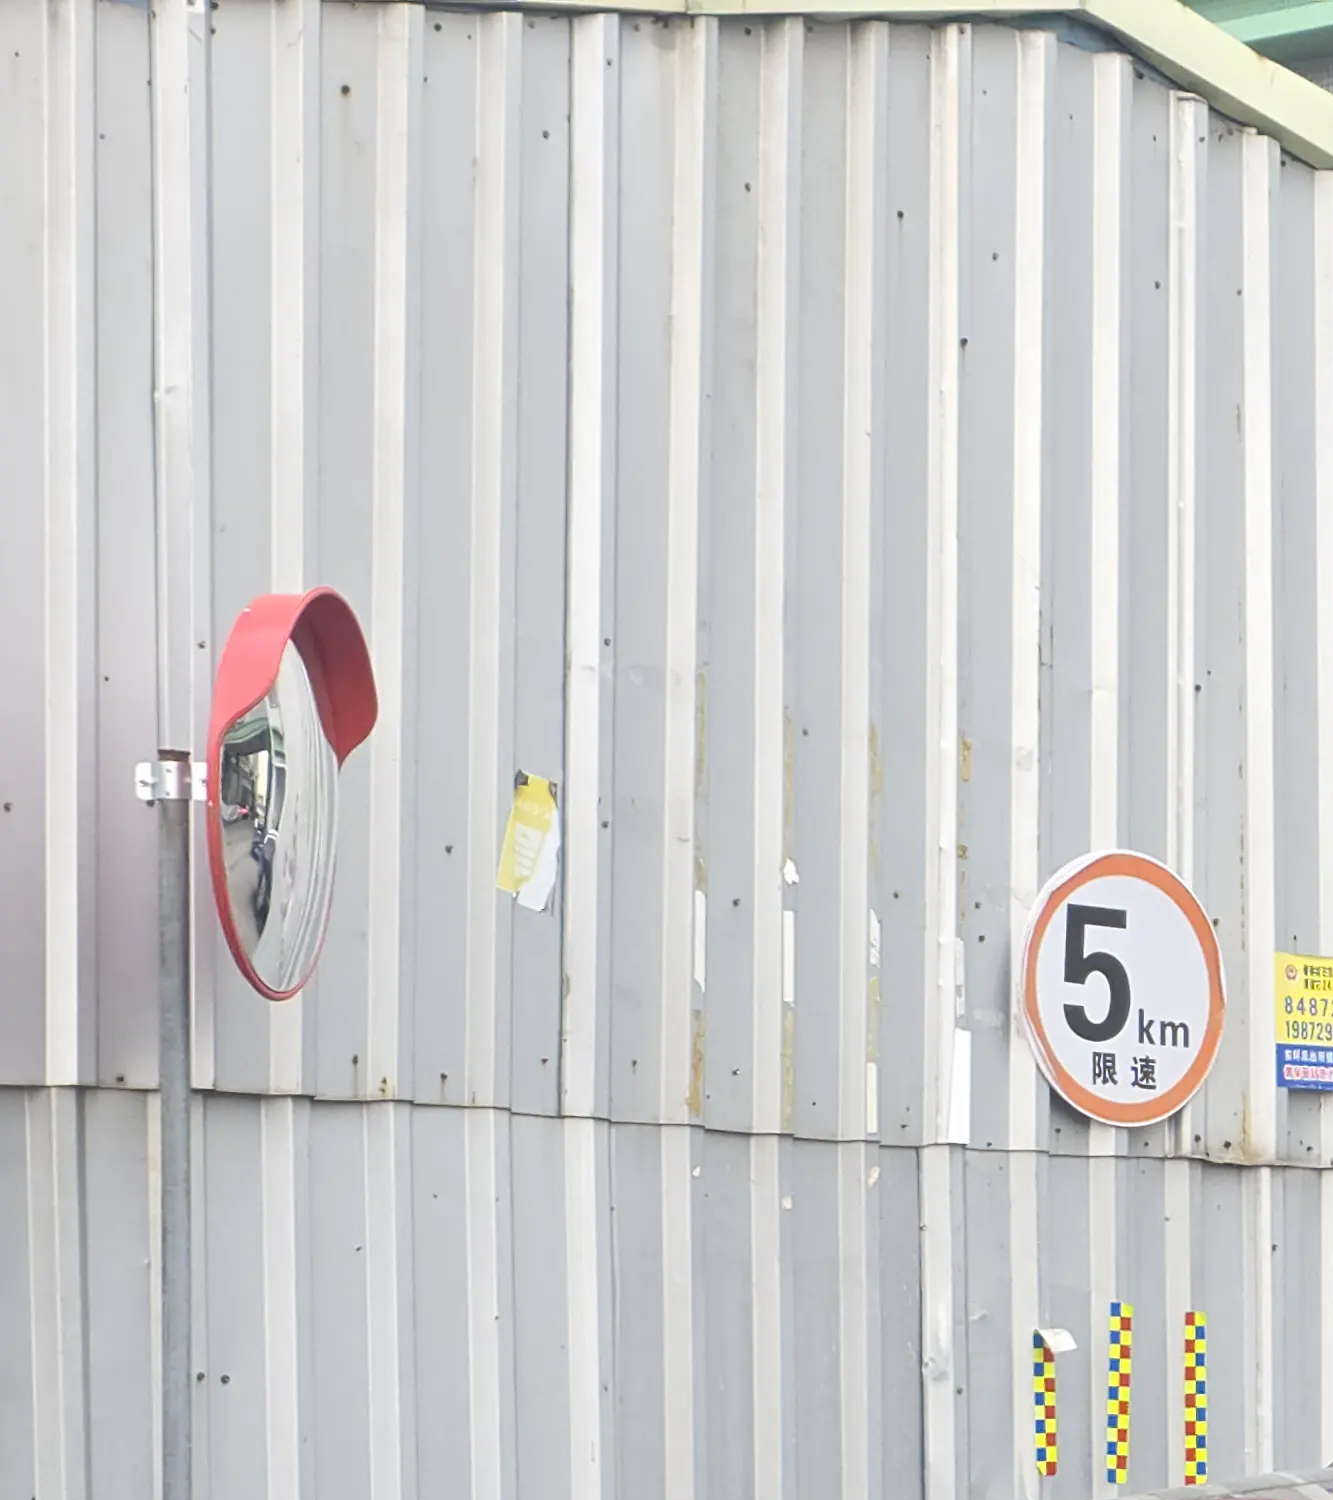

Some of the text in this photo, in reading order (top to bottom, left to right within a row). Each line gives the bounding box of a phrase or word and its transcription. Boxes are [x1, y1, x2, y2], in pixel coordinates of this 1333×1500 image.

[1063, 903, 1190, 1048] 5 km
[1092, 1051, 1158, 1091] 限速
